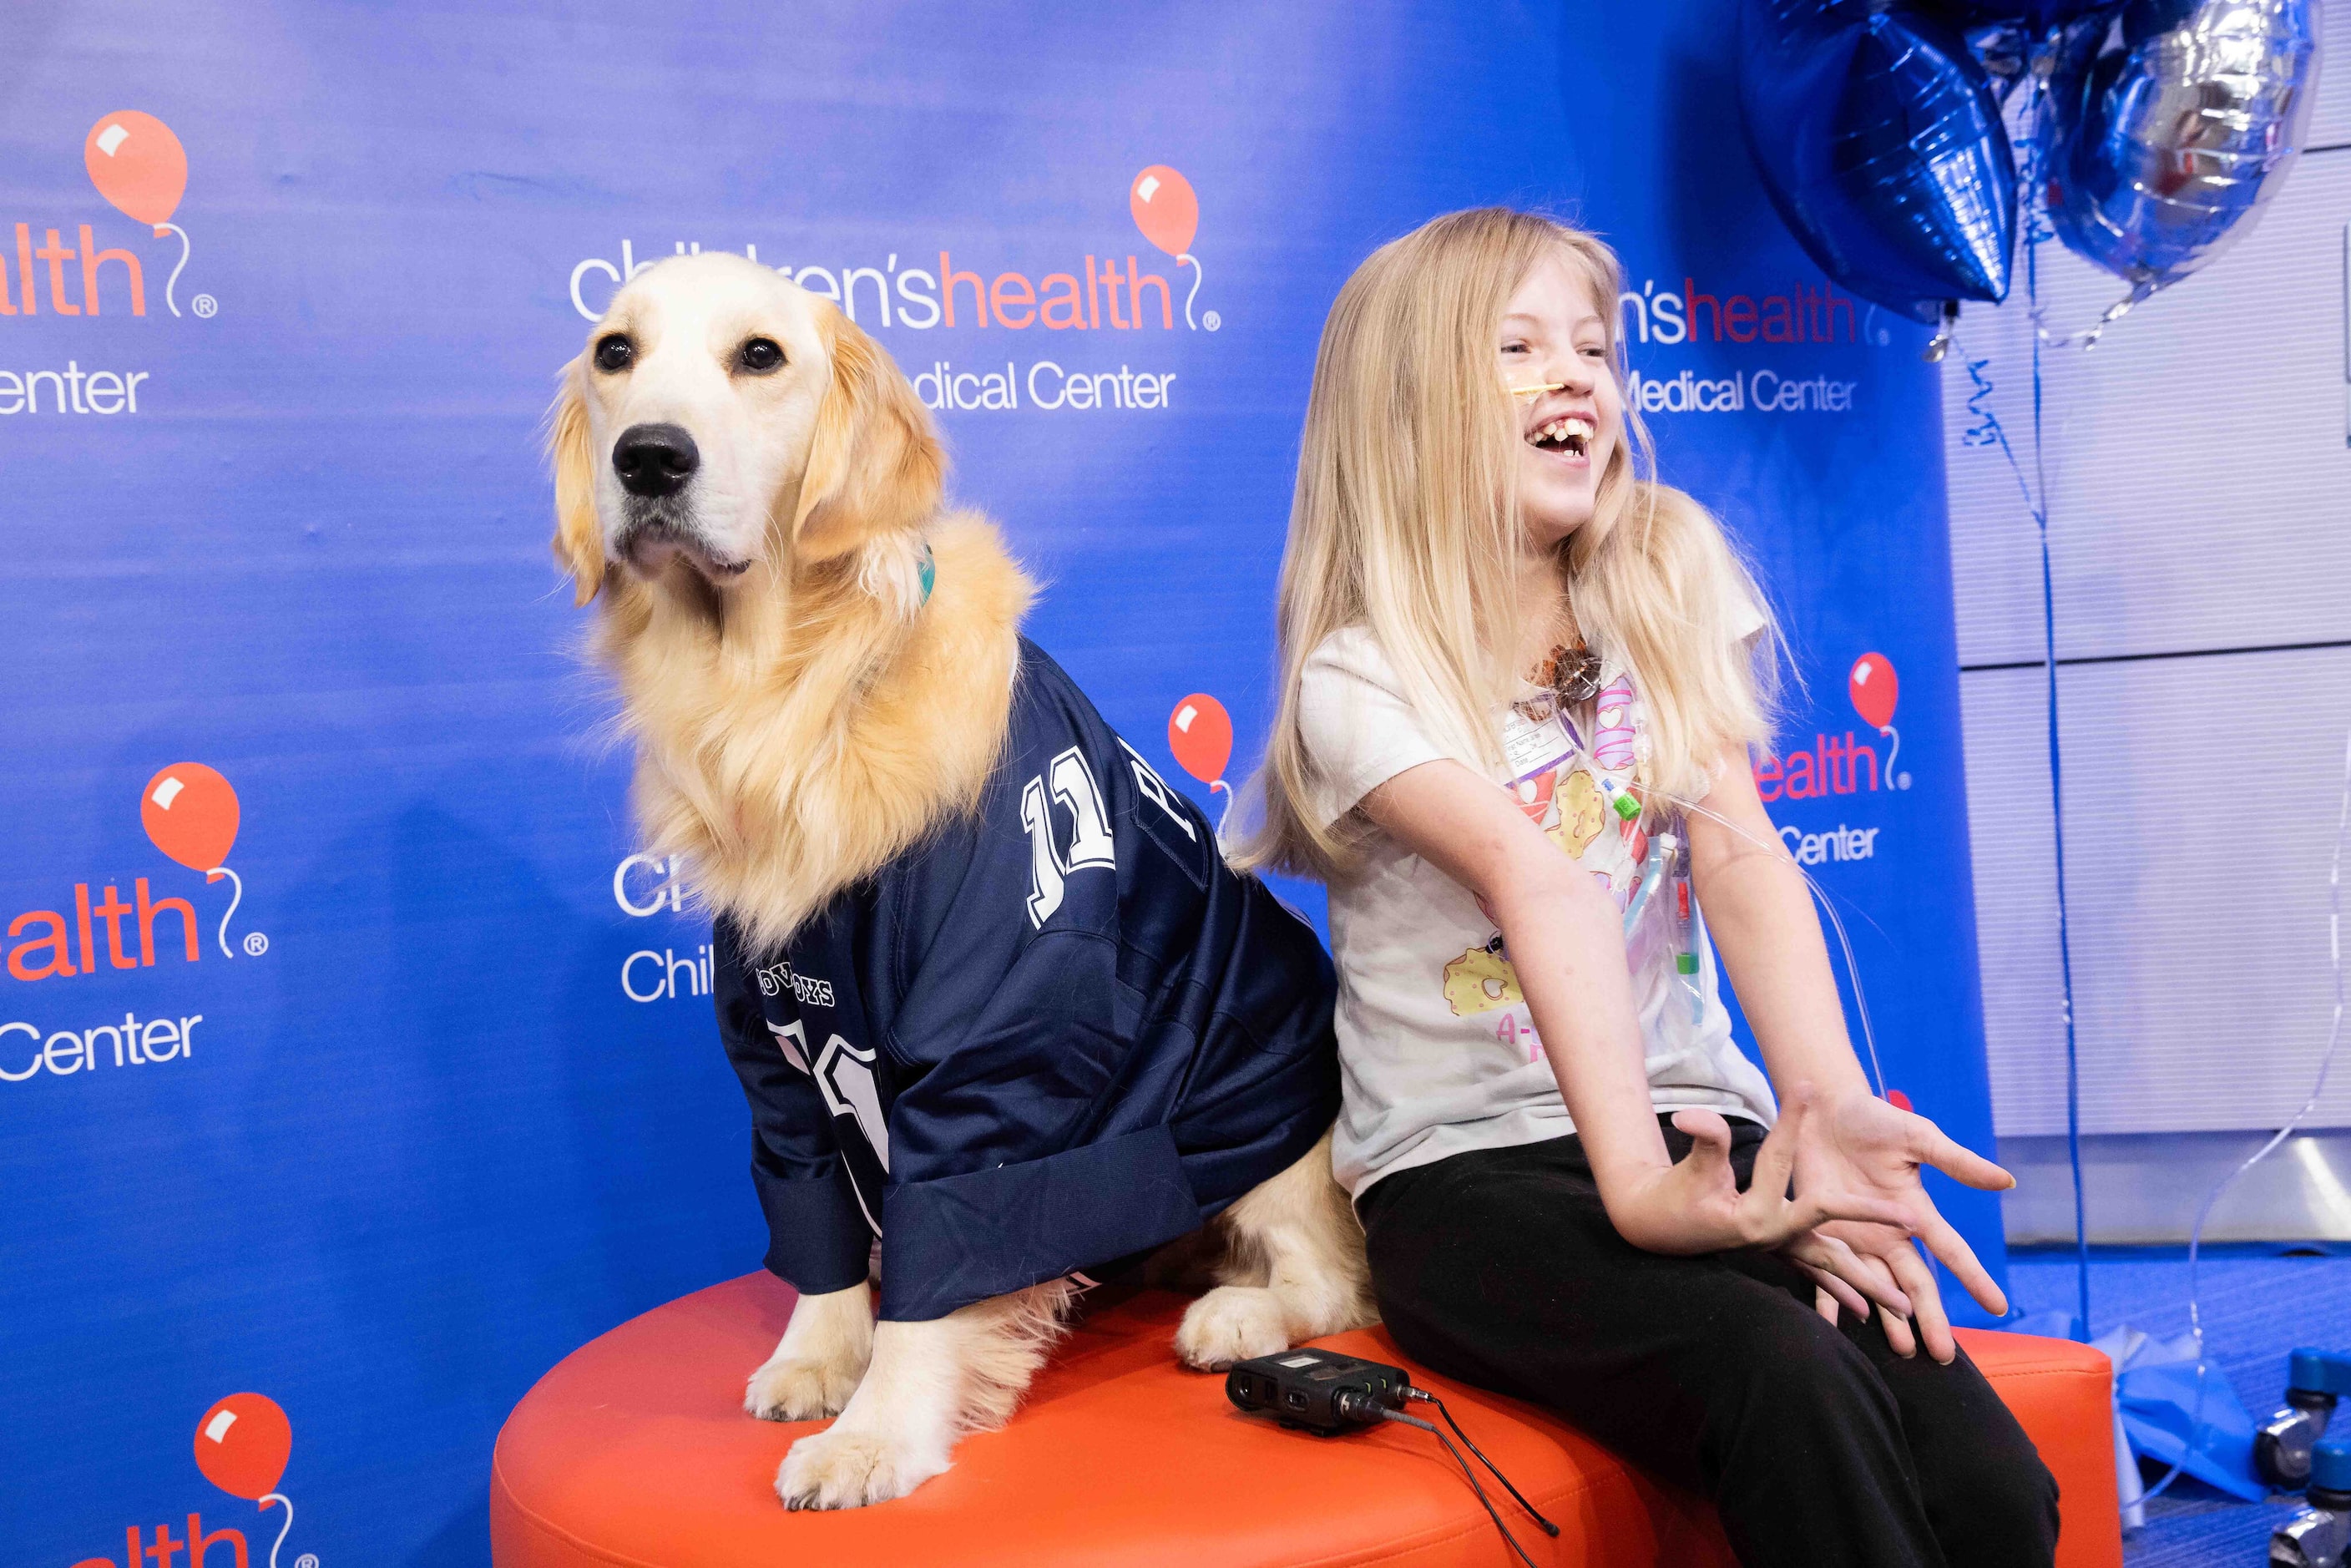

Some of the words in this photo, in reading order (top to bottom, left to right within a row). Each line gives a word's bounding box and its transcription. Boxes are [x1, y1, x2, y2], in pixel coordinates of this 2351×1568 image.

[0, 222, 146, 316] lth
[1027, 360, 1176, 410] Center
[1751, 369, 1858, 412] Center
[0, 877, 200, 982] alth
[0, 1012, 203, 1082] Center
